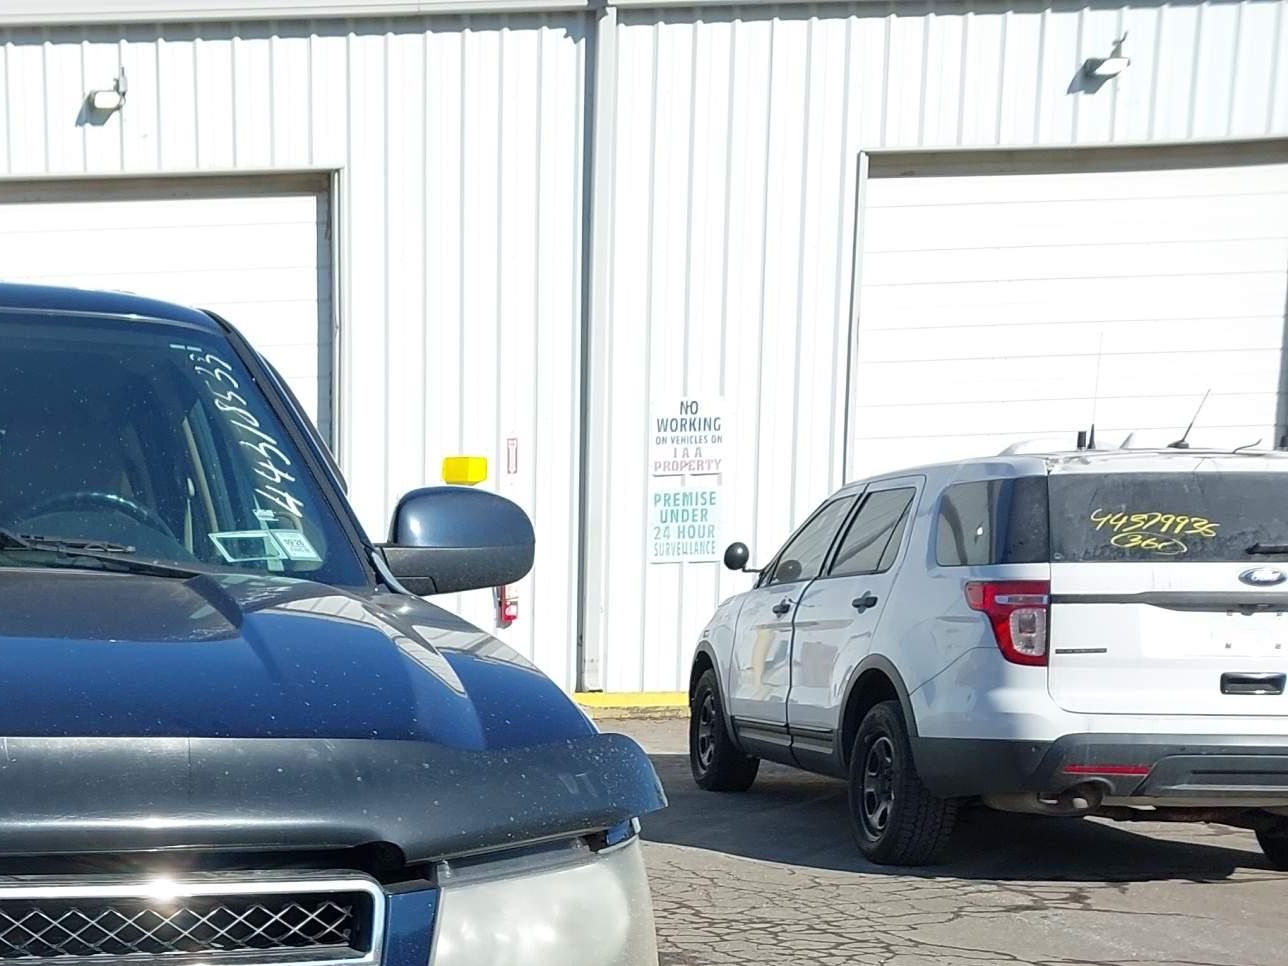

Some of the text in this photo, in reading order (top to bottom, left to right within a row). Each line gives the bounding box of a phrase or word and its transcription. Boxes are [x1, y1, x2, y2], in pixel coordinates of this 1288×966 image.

[679, 400, 699, 416] NO
[656, 416, 721, 433] WORKING
[655, 434, 723, 446] ON VEHICLES ON
[653, 458, 723, 472] PROPERTY
[653, 491, 718, 508] PREMISE
[659, 508, 709, 524] UNDER
[653, 524, 716, 540] 24 HOUR
